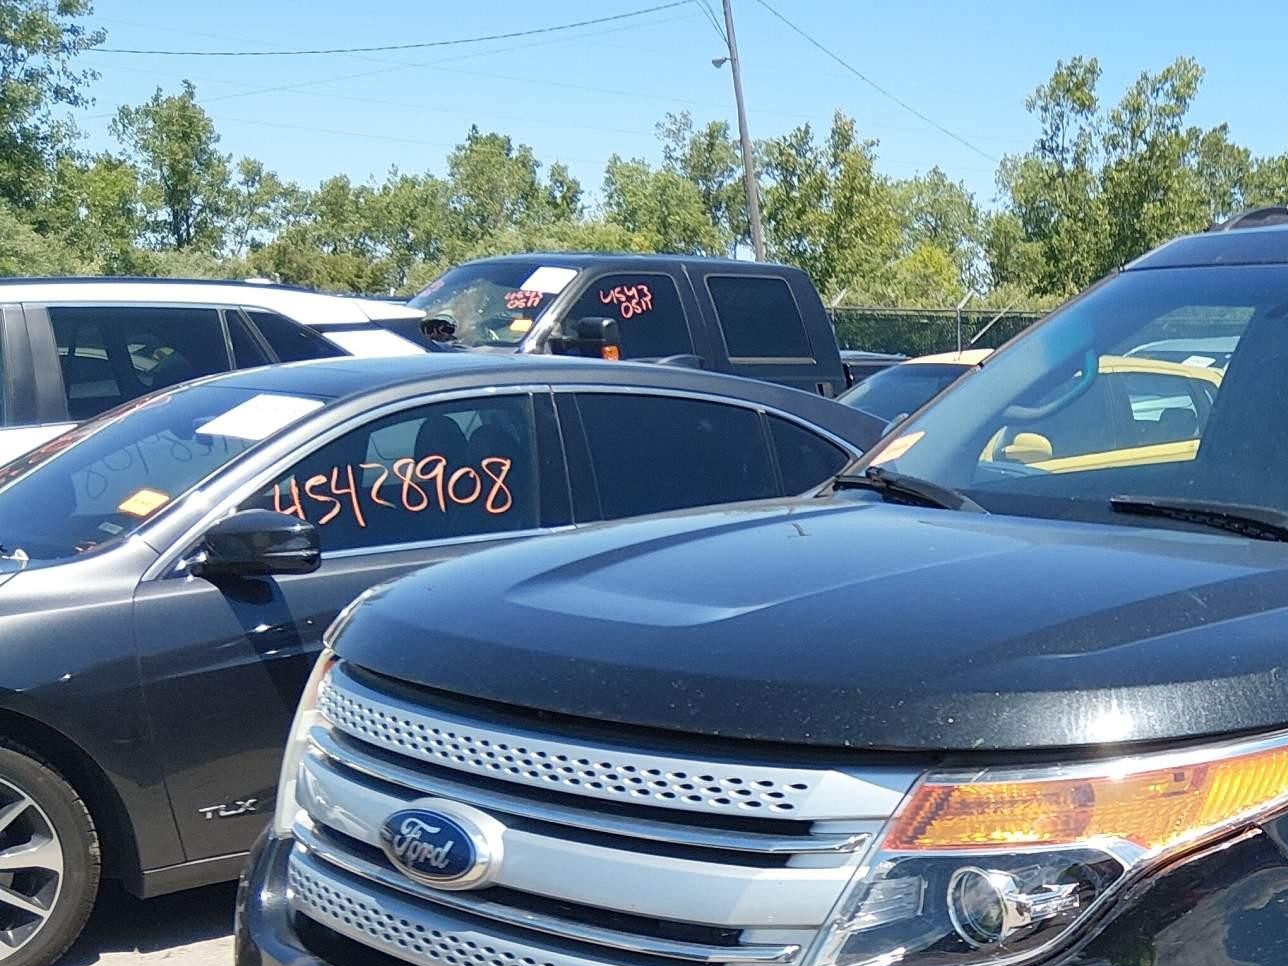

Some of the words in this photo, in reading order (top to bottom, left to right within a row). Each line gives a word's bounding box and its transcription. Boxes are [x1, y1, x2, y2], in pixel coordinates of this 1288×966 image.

[600, 284, 652, 304] 4543
[274, 455, 513, 527] 45428908
[198, 799, 258, 820] TLX
[393, 817, 453, 869] Ford
